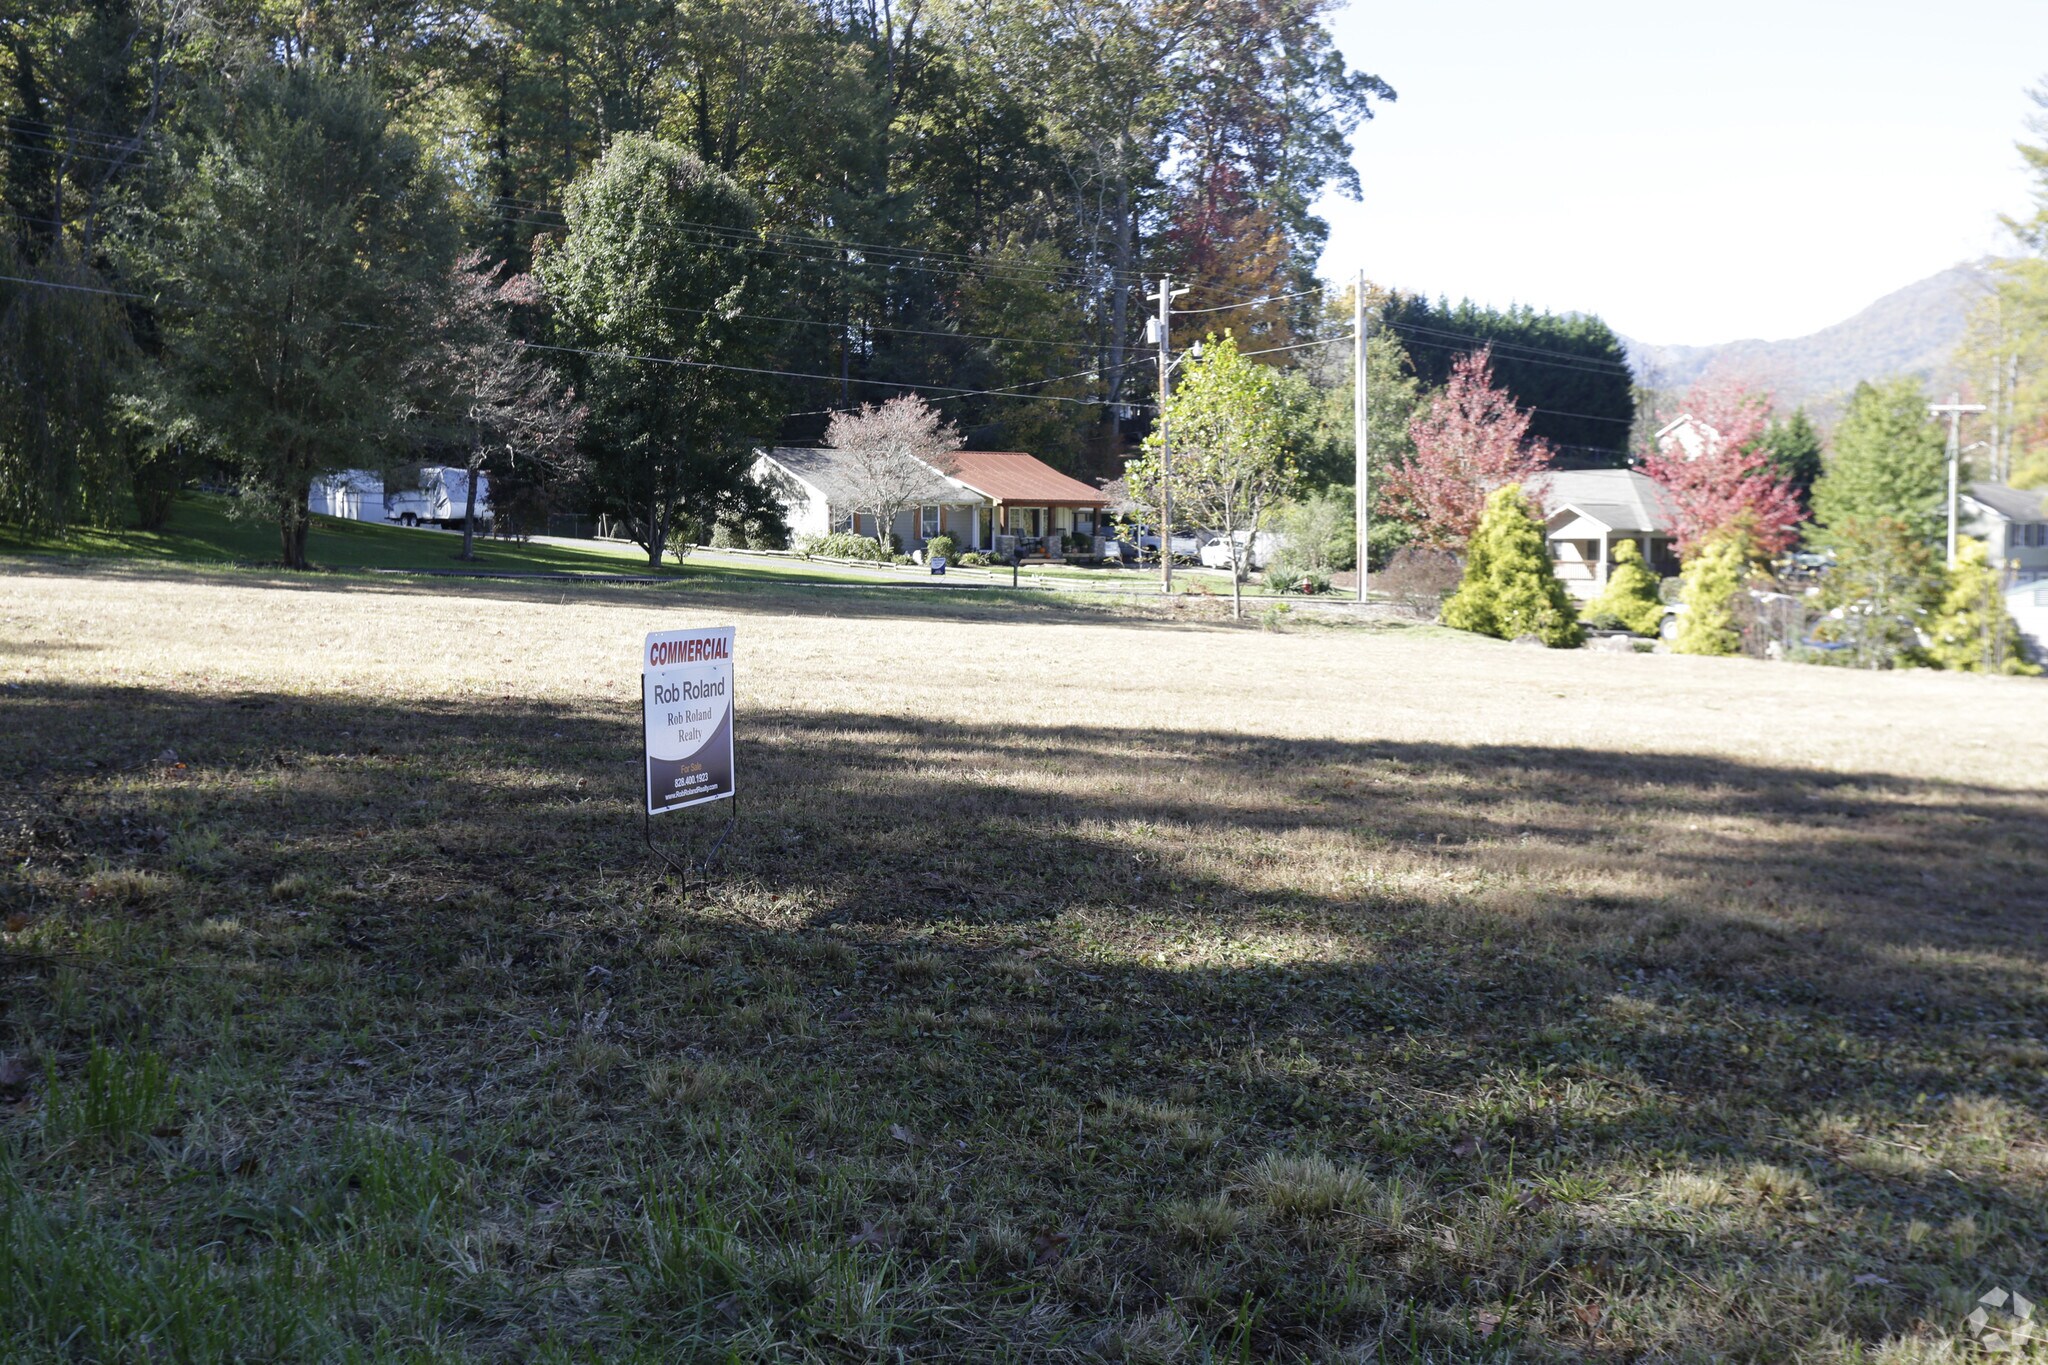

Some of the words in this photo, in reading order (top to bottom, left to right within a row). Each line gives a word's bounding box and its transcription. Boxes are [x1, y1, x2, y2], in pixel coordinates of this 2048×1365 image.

[650, 637, 729, 667] COMMERCIAL
[654, 682, 680, 705] Rob
[683, 676, 725, 701] Roland
[667, 711, 684, 727] Rob
[685, 706, 712, 724] Roland
[678, 726, 703, 743] Realty
[680, 764, 690, 774] For
[690, 762, 702, 772] Sale
